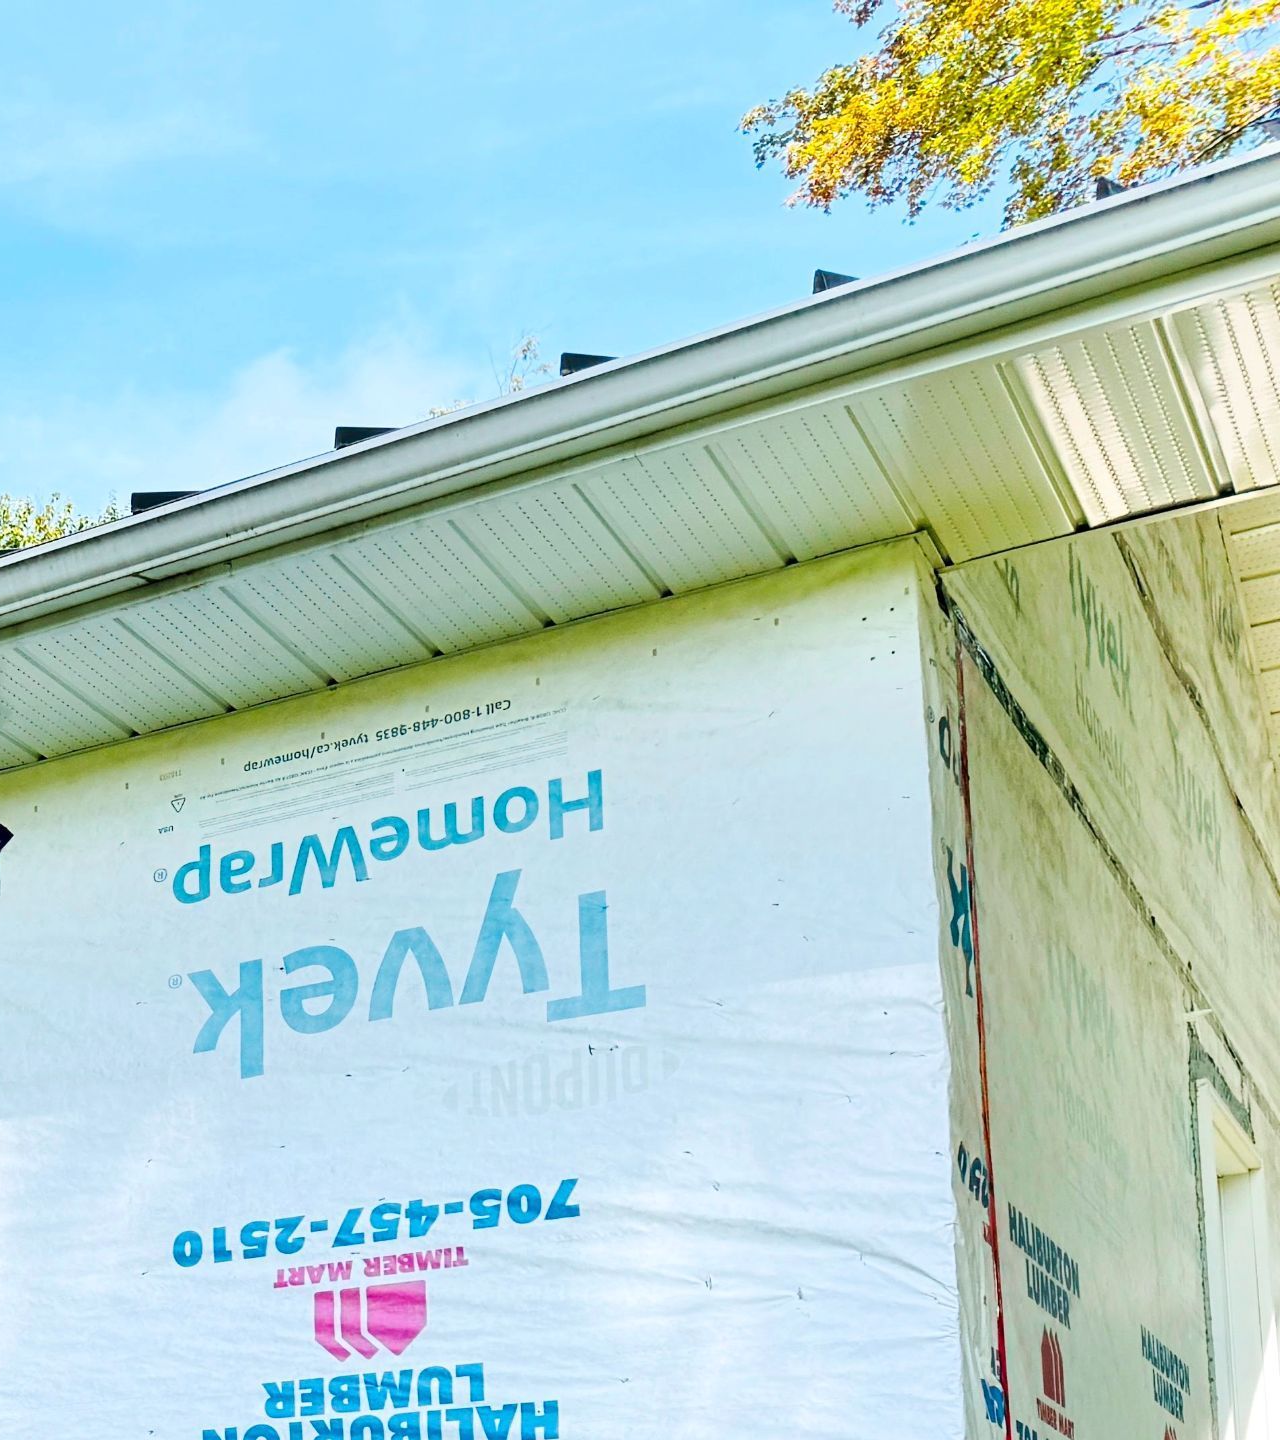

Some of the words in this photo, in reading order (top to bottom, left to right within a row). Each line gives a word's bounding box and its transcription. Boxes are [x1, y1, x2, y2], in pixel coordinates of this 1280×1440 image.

[375, 705, 483, 742] 1-800-448-9835
[485, 699, 512, 716] Call
[243, 731, 370, 773] tyvek.ca/homewrap
[172, 768, 604, 904] HomeWrap
[186, 867, 647, 1080] Tyvek
[172, 1178, 581, 1268] 705-457-2510
[1008, 1201, 1080, 1299] HALIBURTON
[273, 1260, 353, 1289] MART
[363, 1245, 469, 1278] TIMBER
[1025, 1258, 1071, 1330] LUMBER
[262, 1362, 484, 1418] LUMBER
